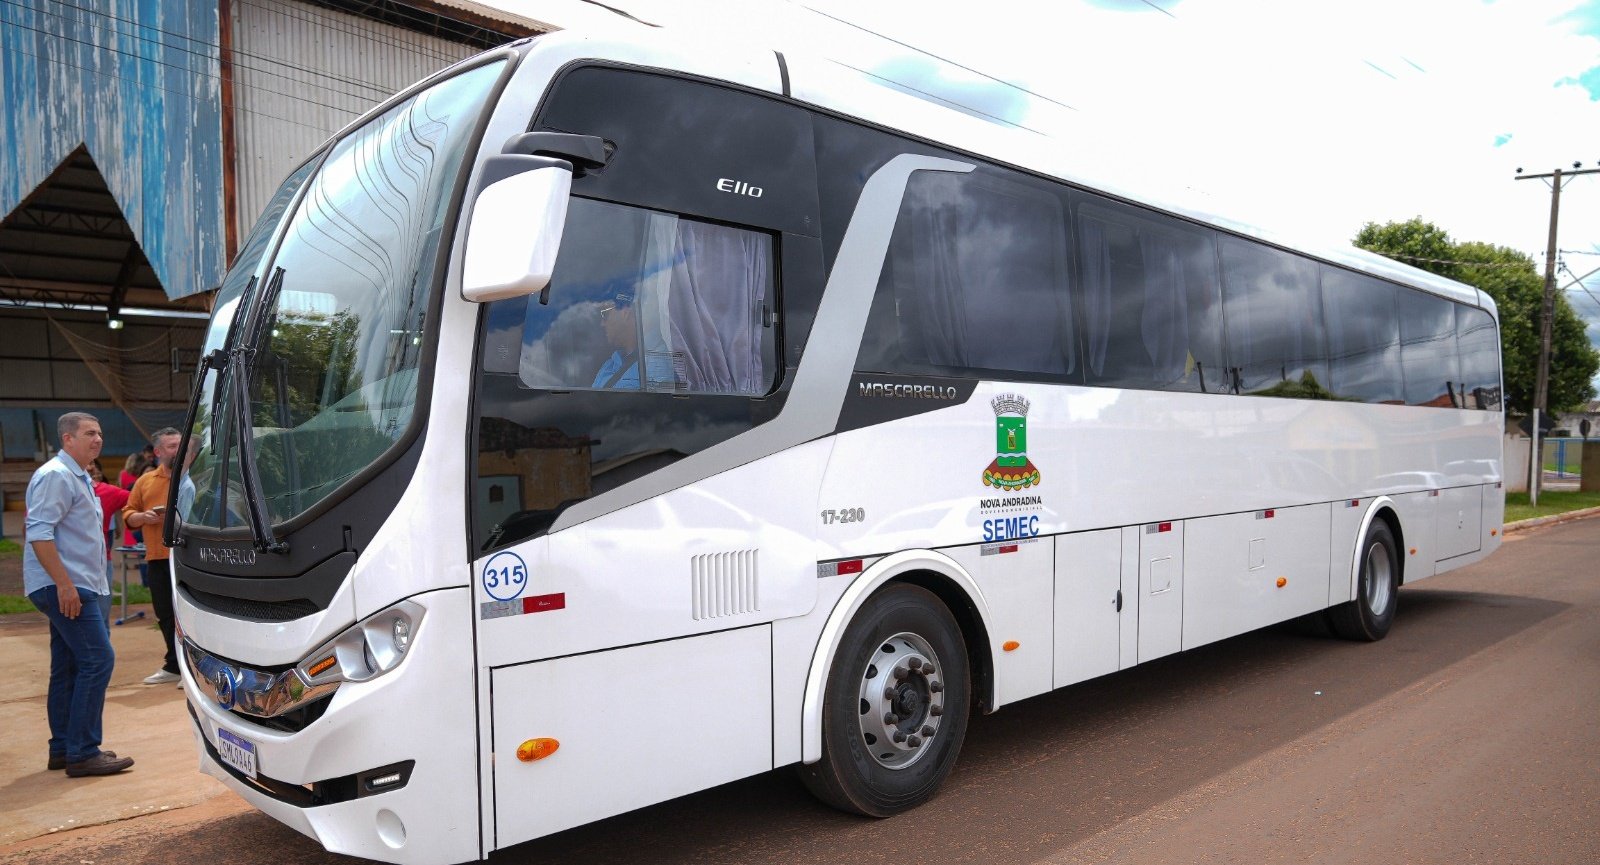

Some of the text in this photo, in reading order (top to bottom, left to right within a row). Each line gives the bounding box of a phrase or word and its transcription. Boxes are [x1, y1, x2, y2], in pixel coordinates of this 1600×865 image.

[716, 178, 763, 198] Ello
[860, 382, 956, 400] MASCARELLO
[980, 496, 1042, 509] NOVA ANDRADINA
[820, 507, 865, 525] 17-230
[983, 515, 1039, 543] SEMEC
[486, 565, 524, 588] 315
